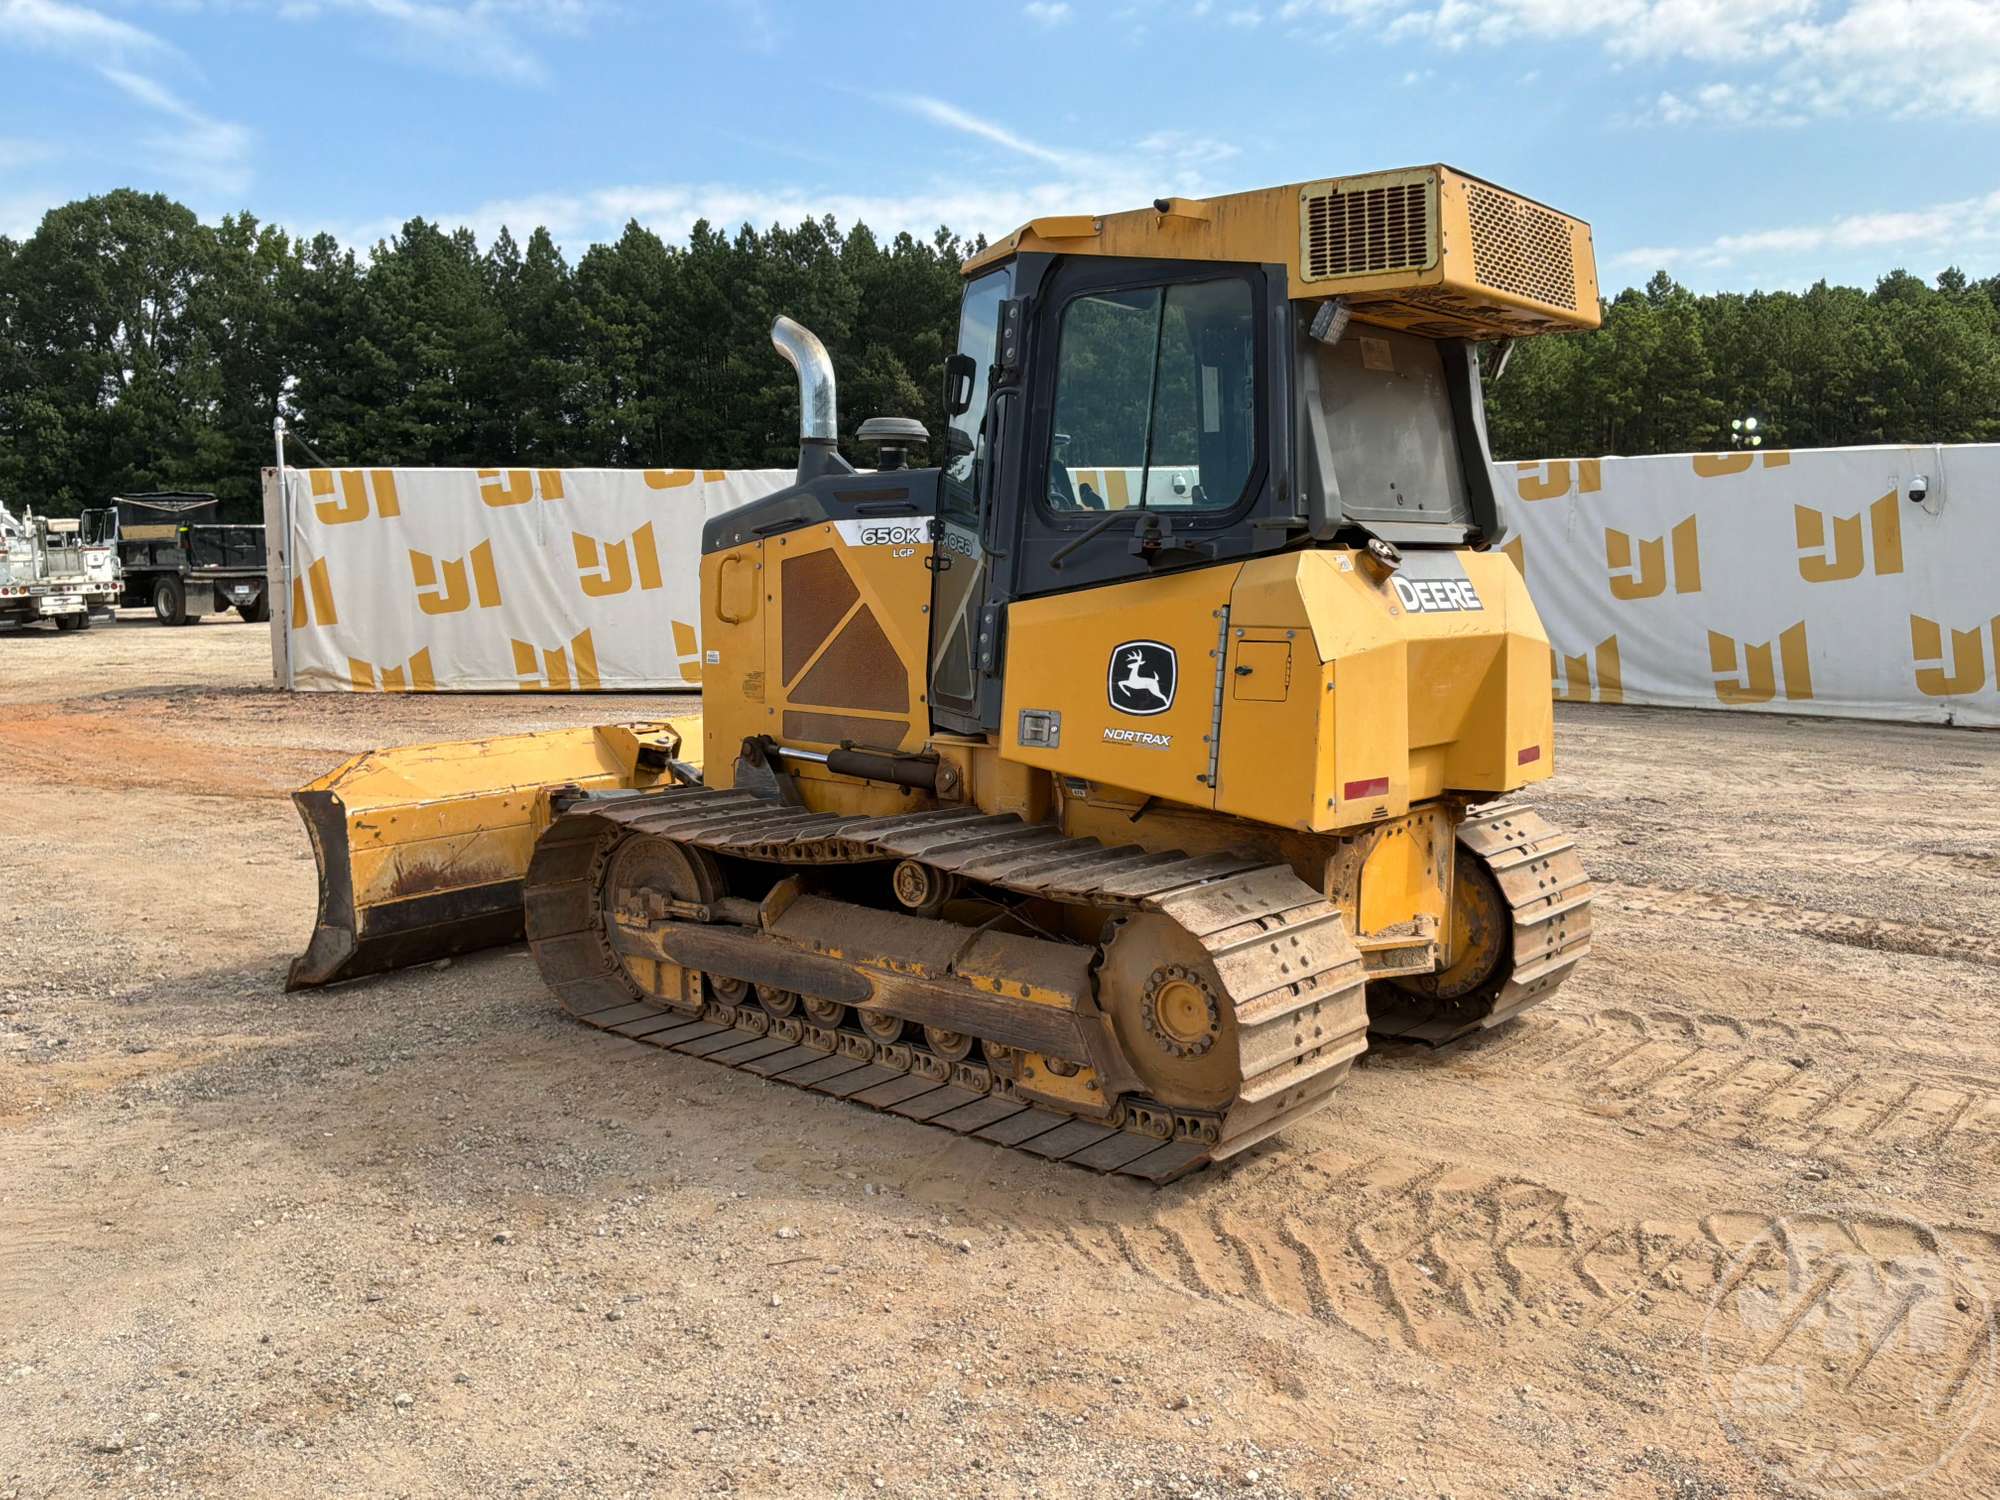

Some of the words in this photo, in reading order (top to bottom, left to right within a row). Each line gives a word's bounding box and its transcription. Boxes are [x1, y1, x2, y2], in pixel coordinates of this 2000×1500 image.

[862, 527, 920, 545] 650K
[893, 548, 915, 558] LGP
[1391, 575, 1483, 612] DEERE
[1103, 728, 1172, 745] NORTRAX
